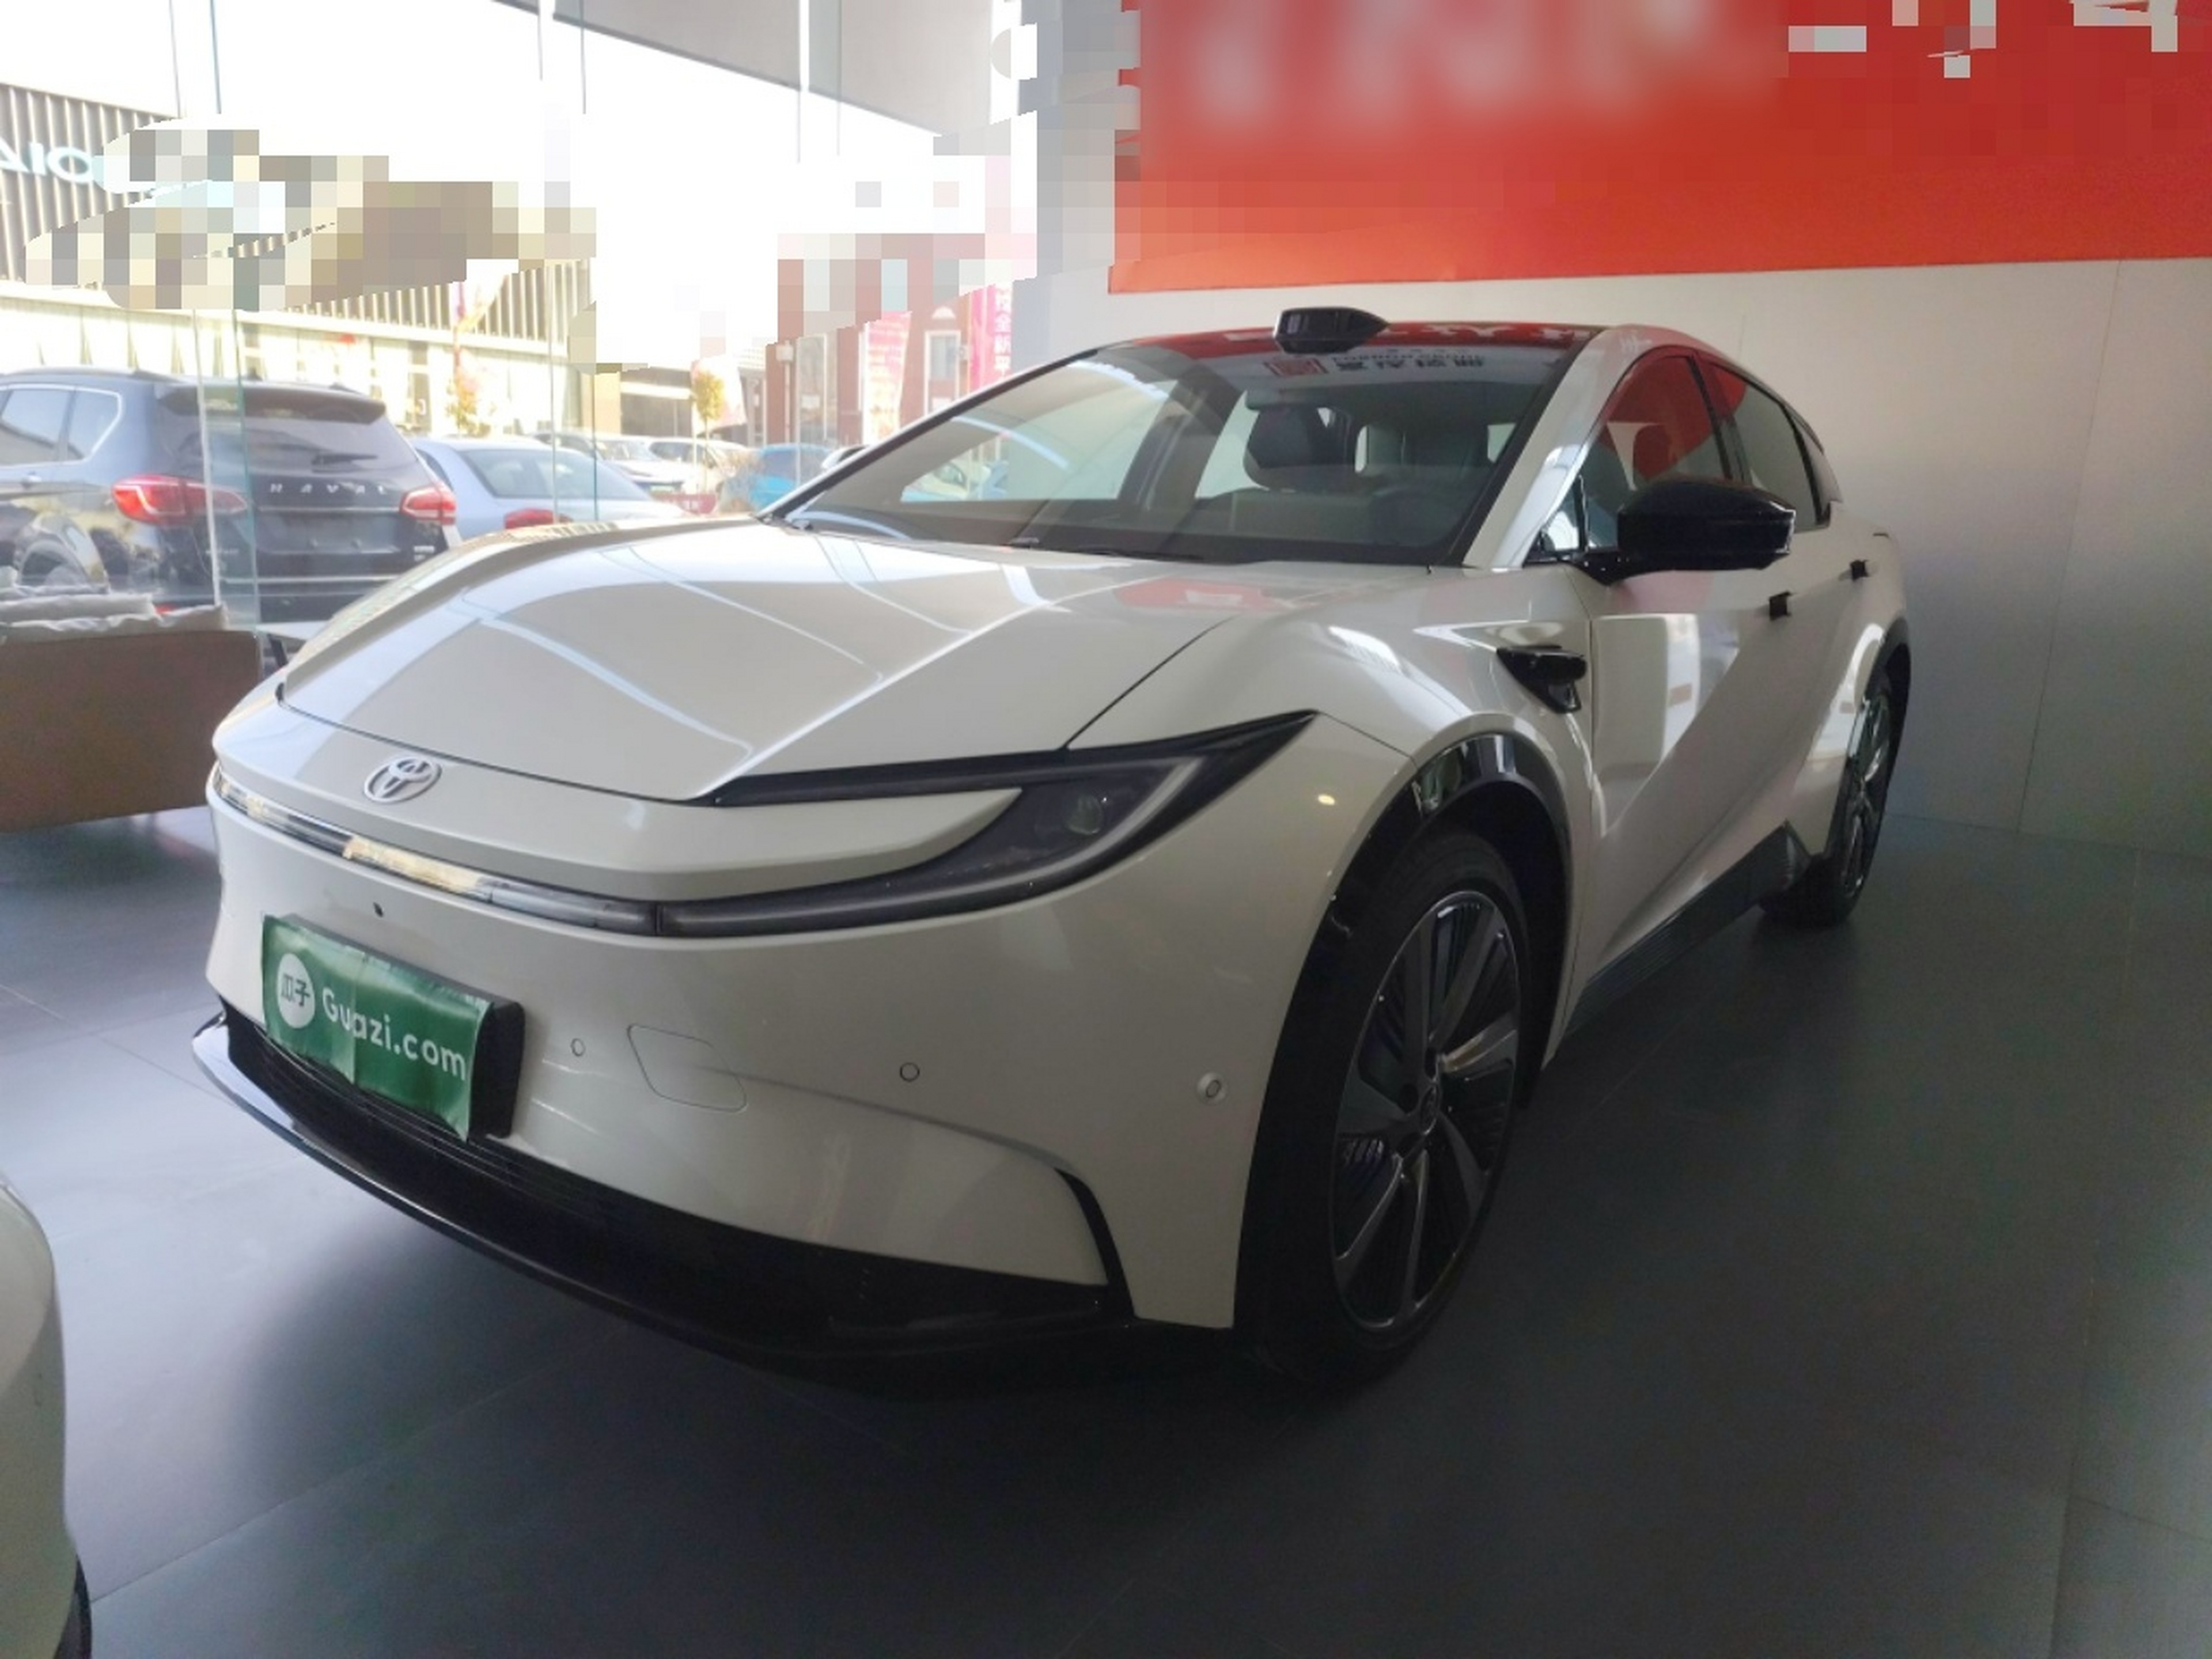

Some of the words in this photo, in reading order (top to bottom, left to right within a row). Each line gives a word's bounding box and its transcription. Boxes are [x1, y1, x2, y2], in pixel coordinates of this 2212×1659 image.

[270, 483, 386, 494] HAVAL
[282, 974, 311, 1007] 瓜子
[322, 987, 466, 1081] Guazi.com
